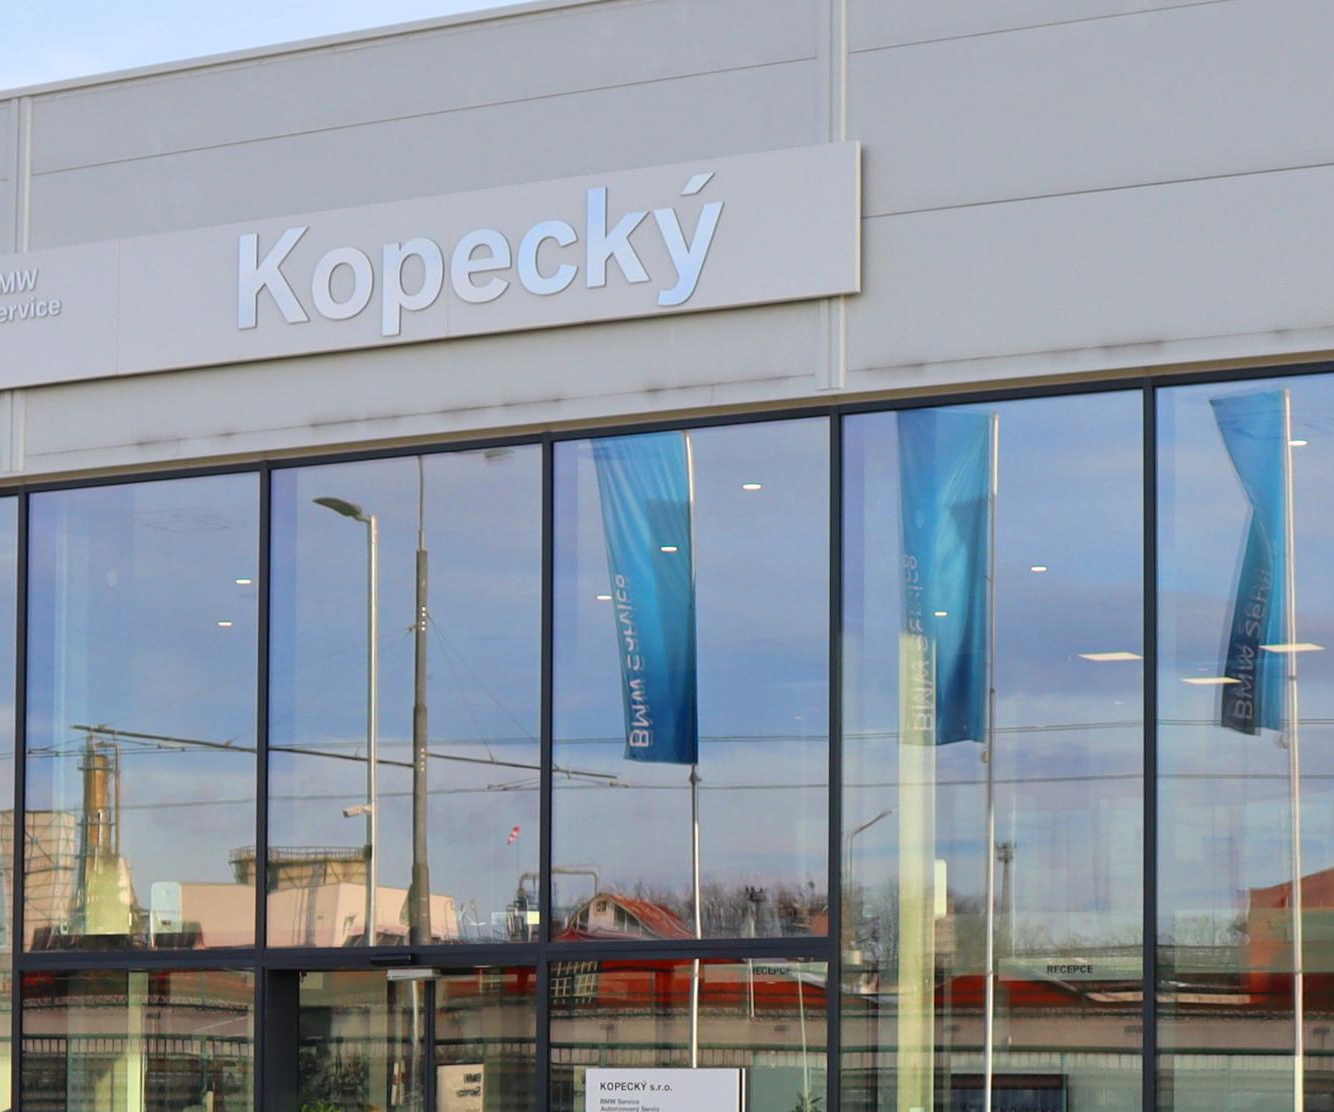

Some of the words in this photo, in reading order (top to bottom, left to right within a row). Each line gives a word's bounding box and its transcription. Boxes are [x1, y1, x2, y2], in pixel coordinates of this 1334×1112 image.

[237, 172, 725, 337] Kopecký
[1047, 964, 1094, 974] RECEPCE
[599, 1080, 647, 1092] KOPECKÝ
[649, 1084, 673, 1092] s.r.o.
